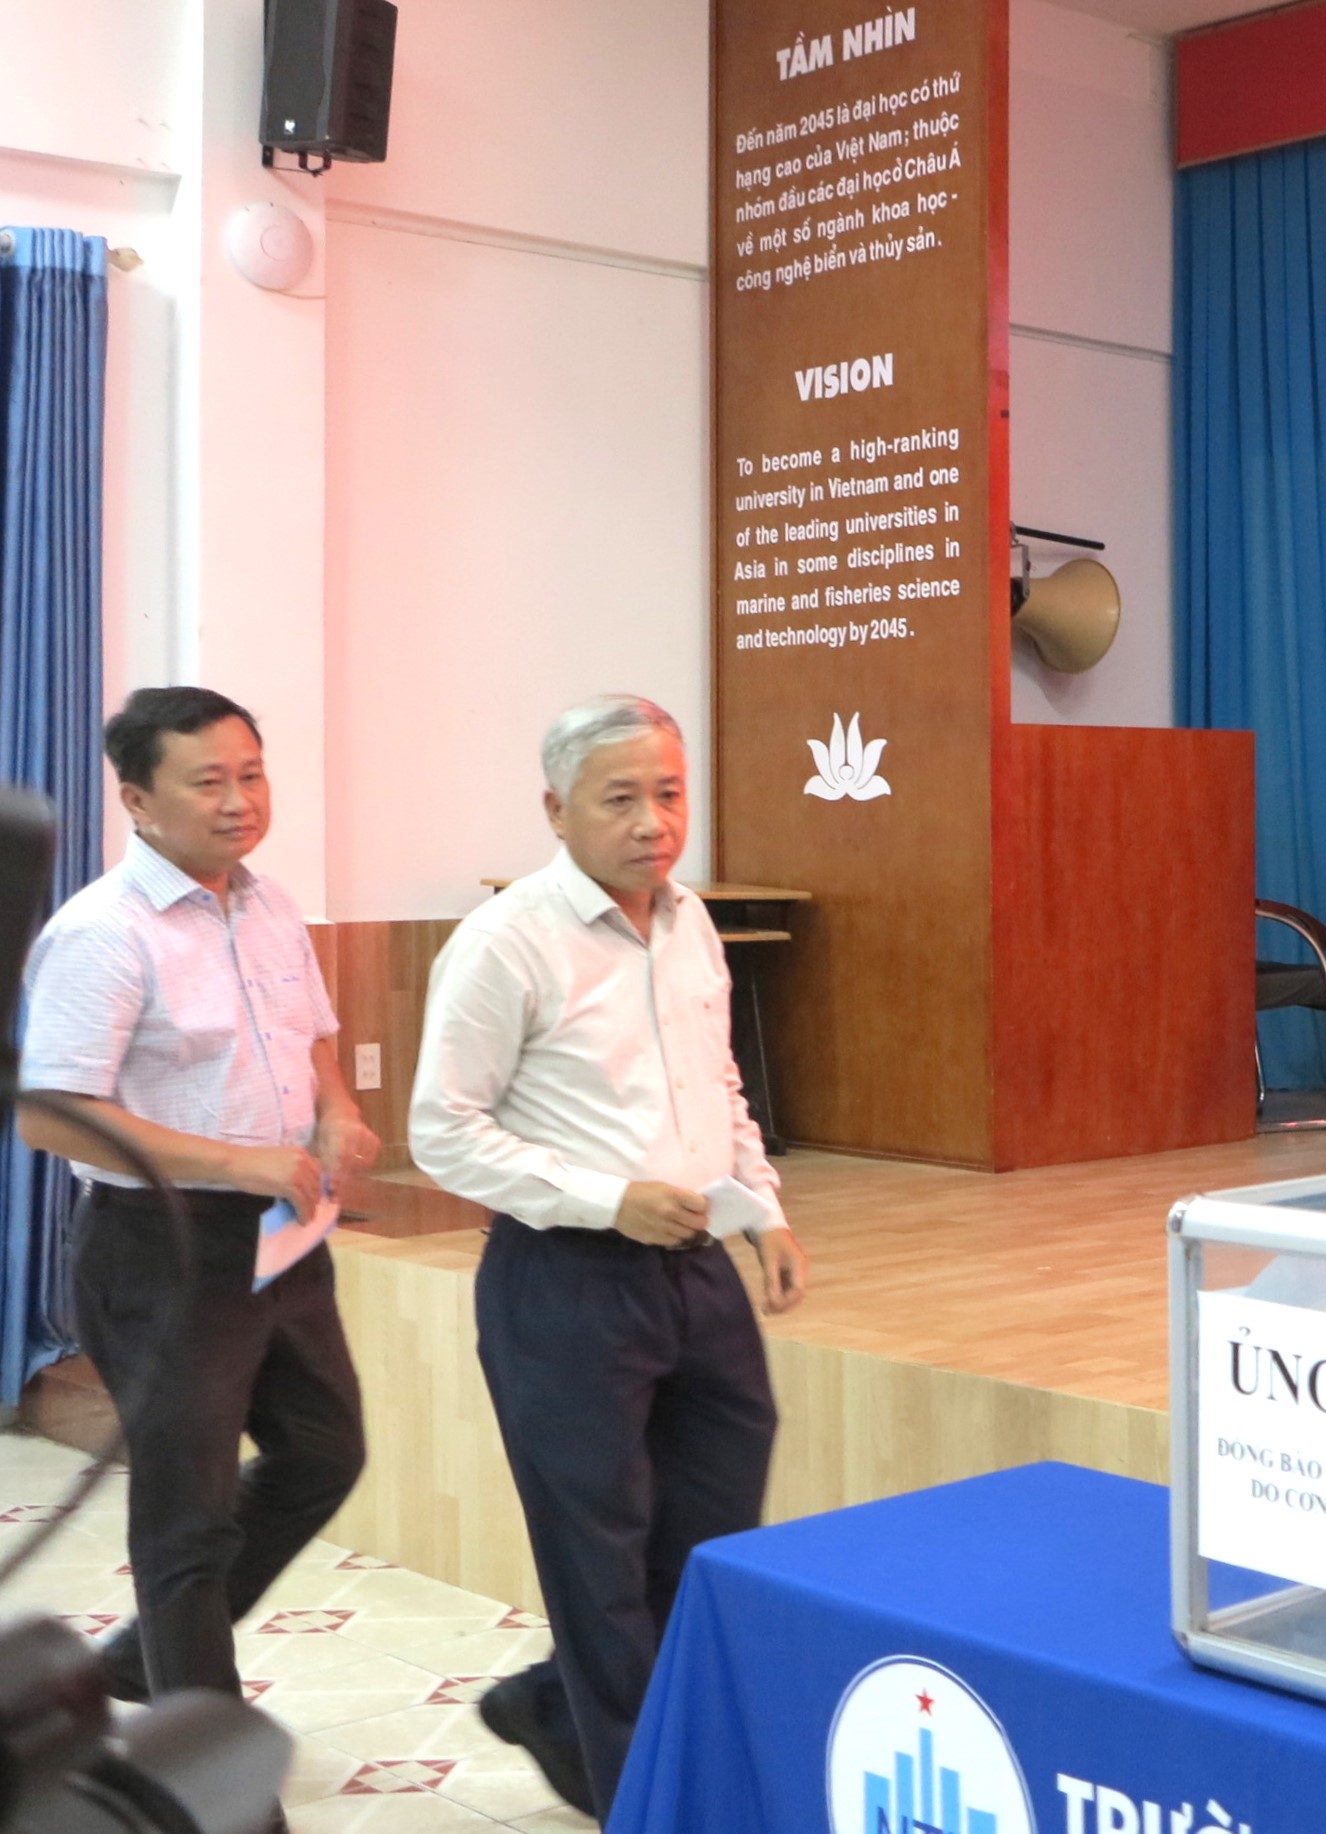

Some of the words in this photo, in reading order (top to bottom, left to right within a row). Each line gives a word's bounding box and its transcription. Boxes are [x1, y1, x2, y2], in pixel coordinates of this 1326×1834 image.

[776, 31, 833, 81] TẦM
[843, 6, 916, 61] NHÌN
[736, 127, 764, 154] Đến
[766, 123, 797, 145] năm
[799, 108, 834, 136] 2045
[837, 103, 850, 125] là
[852, 95, 876, 121] đại
[879, 91, 908, 115] học
[910, 79, 930, 104] có
[932, 71, 961, 98] thứ
[736, 167, 771, 191] hạng
[776, 158, 802, 178] cao
[806, 145, 832, 170] của
[836, 137, 864, 163] Việt
[913, 111, 959, 140] thuộc
[736, 197, 775, 223] nhóm
[779, 186, 805, 211] đầu
[808, 181, 834, 204] các
[836, 173, 860, 199] đại
[863, 166, 891, 192] học
[904, 153, 947, 179] Châu
[948, 141, 961, 169] Á
[737, 232, 754, 257] về
[760, 228, 787, 252] một
[793, 218, 811, 243] số
[817, 209, 864, 240] ngành
[872, 201, 910, 224] khoa
[917, 191, 948, 215] học
[736, 270, 771, 291] công
[776, 256, 812, 285] nghệ
[814, 244, 846, 274] biển
[849, 243, 867, 265] và
[869, 233, 904, 261] thủy
[794, 352, 894, 401] VISION
[737, 457, 753, 477] To
[762, 450, 822, 473] become
[831, 447, 841, 463] a
[850, 427, 960, 463] high-ranking
[736, 485, 806, 512] university
[810, 482, 824, 501] in
[828, 476, 889, 499] Vietnam
[893, 467, 924, 491] and
[929, 467, 959, 486] one
[736, 527, 751, 548] of
[755, 525, 779, 545] the
[785, 518, 839, 542] leading
[846, 505, 937, 534] universities
[944, 501, 959, 522] in
[734, 560, 766, 581] Asia
[774, 557, 788, 576] in
[797, 555, 838, 574] some
[847, 542, 934, 573] disciplines
[945, 537, 960, 558] in
[736, 593, 786, 615] marine
[791, 588, 819, 610] and
[824, 583, 891, 607] fisheries
[897, 578, 960, 600] science
[736, 629, 764, 650] and
[765, 624, 847, 648] technology
[849, 621, 869, 645] by
[1250, 1478, 1280, 1502] DO
